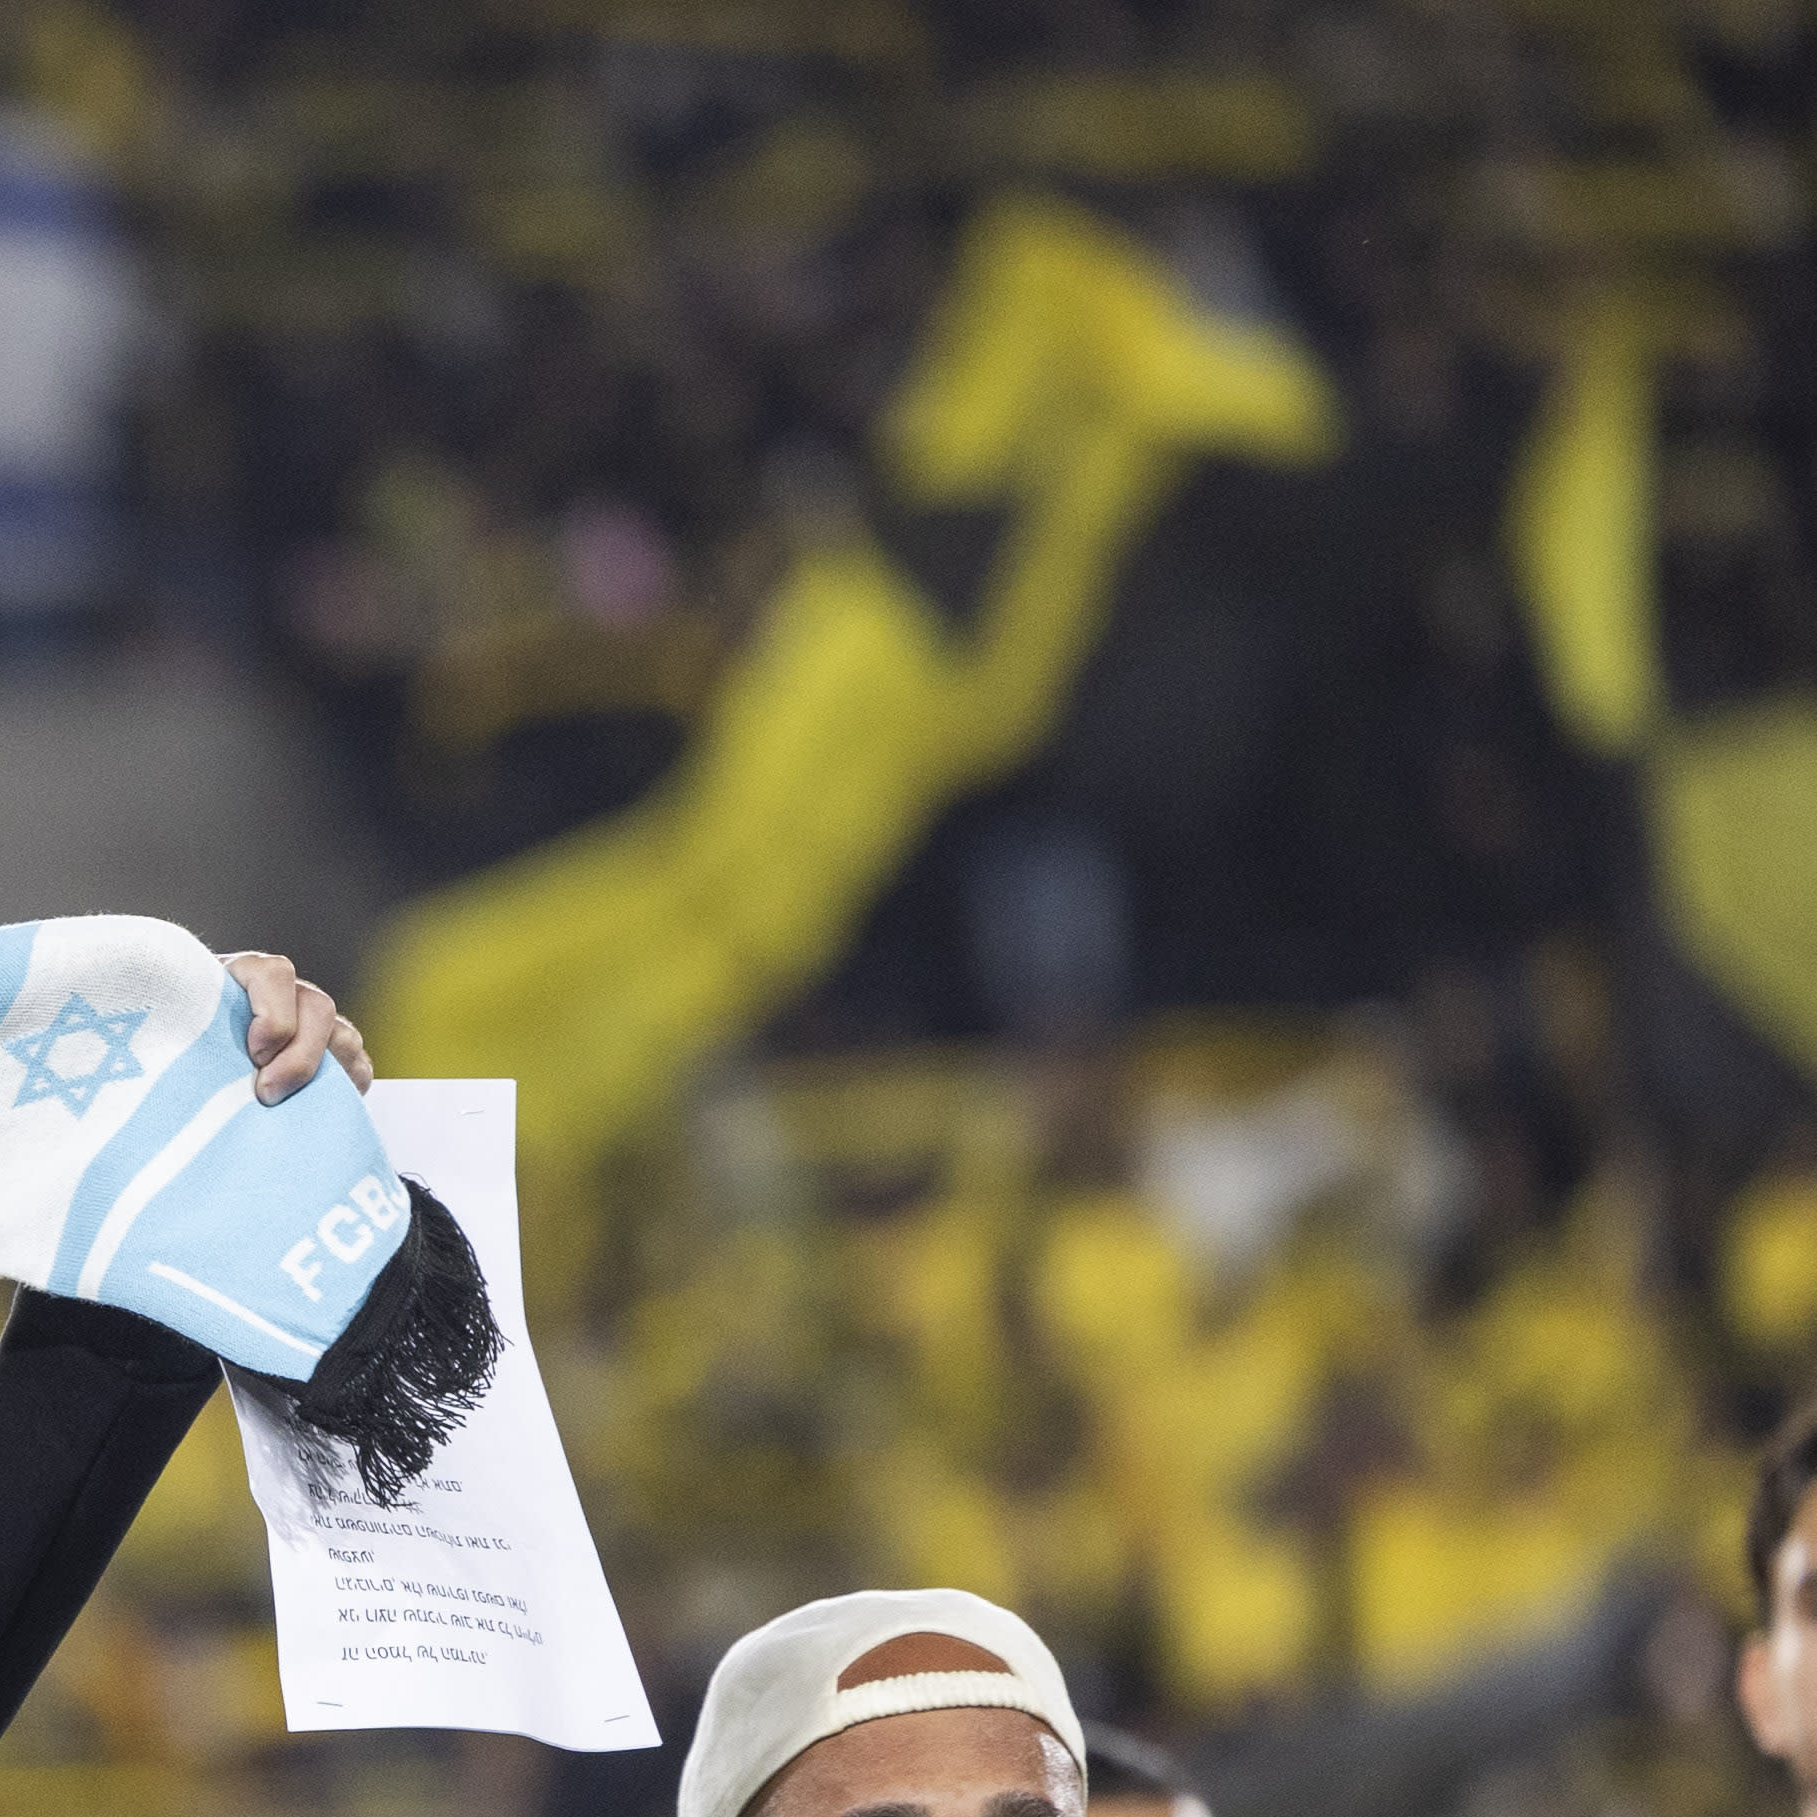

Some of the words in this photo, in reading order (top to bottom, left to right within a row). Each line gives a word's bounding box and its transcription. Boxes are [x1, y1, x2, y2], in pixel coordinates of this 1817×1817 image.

[401, 1580, 423, 1598] אלו
[338, 1608, 360, 1623] אני
[366, 1608, 397, 1623] רוצה
[475, 1618, 495, 1633] את
[341, 1647, 359, 1661] זה
[365, 1646, 413, 1663] הסמל
[416, 1645, 439, 1663] של
